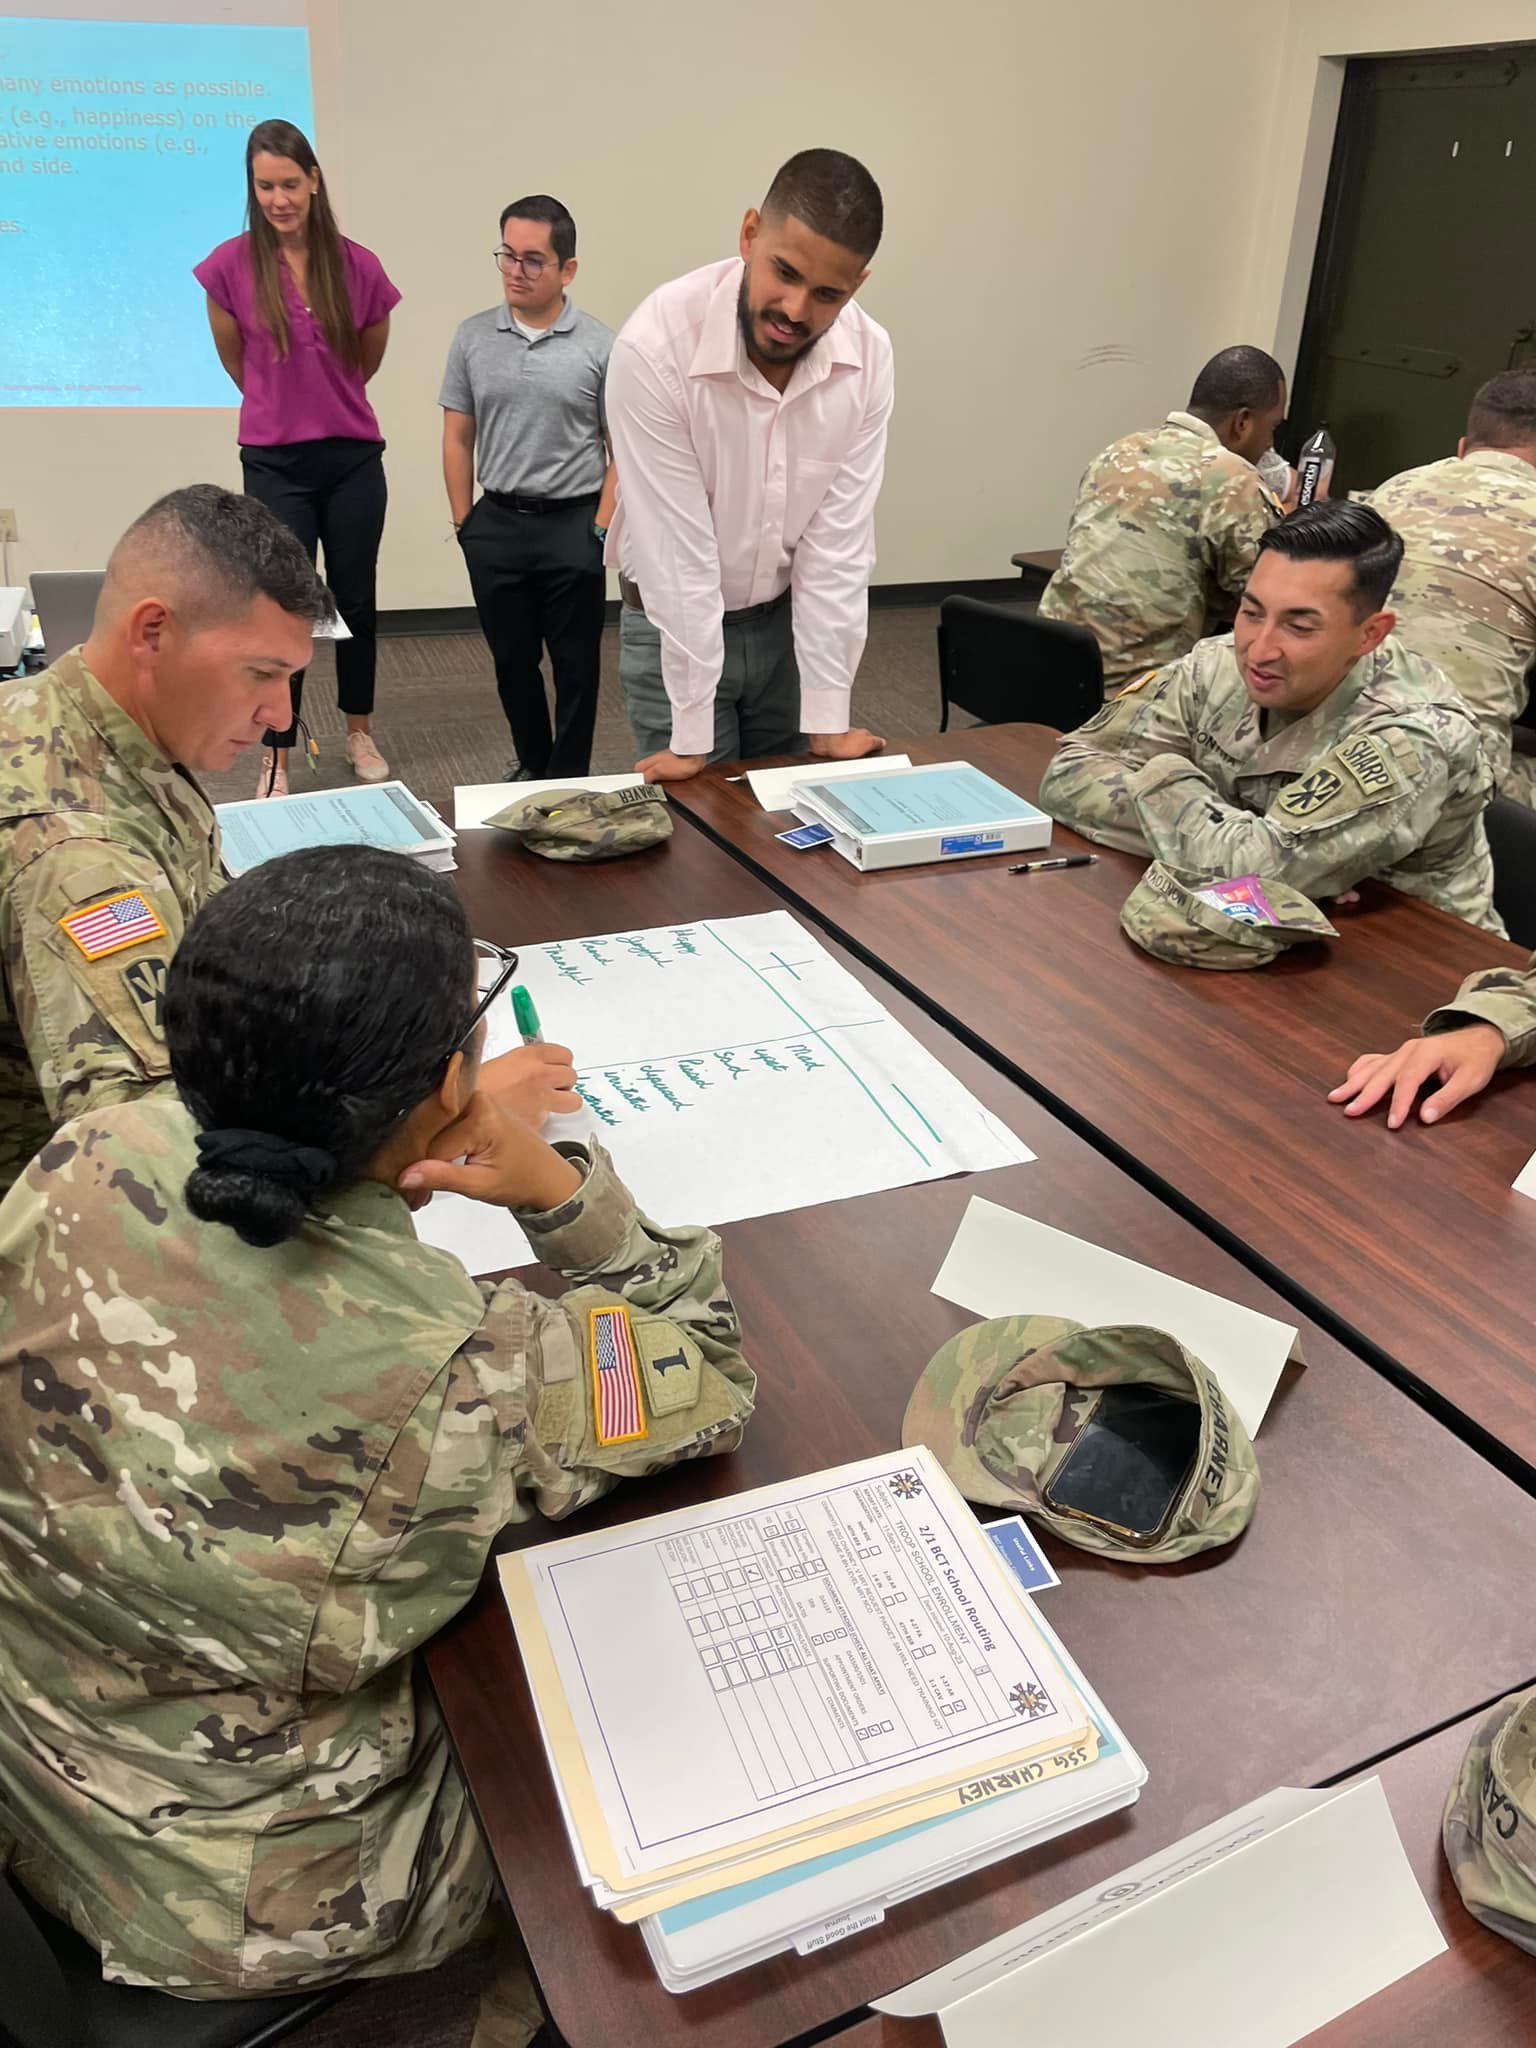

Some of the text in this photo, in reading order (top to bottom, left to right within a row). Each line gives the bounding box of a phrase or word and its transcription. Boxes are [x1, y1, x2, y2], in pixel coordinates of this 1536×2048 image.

[50, 76, 145, 95] emotions
[152, 80, 175, 95] as
[183, 79, 271, 98] possible.
[10, 106, 65, 128] (e.g.,
[72, 106, 185, 130] happiness)
[192, 111, 217, 127] on
[225, 110, 256, 128] the
[53, 132, 146, 151] emotions
[155, 134, 208, 155] (e.g.,
[32, 157, 79, 175] side.
[1342, 740, 1390, 787] SHARP
[580, 939, 614, 966] Proud
[616, 936, 673, 968] Joyful
[668, 929, 701, 956] Happy
[541, 943, 593, 986] Thankful
[714, 1051, 749, 1080] Sad
[786, 1044, 825, 1072] Mad
[604, 1068, 651, 1112] irritated
[1201, 1378, 1229, 1507] CHARNEY
[845, 1568, 860, 1586] LEVEL
[894, 1520, 916, 1549] TROOP
[910, 1549, 936, 1586] SCHOOL
[930, 1585, 970, 1646] ENROLLMENT
[916, 1524, 999, 1652] 2/1 BCT School Routing
[940, 1632, 964, 1665] 10-Aug-23
[821, 1656, 859, 1727] SUPPORTING DOCUMENTS
[833, 1653, 867, 1714] APPOINTMENT ORDERS
[915, 1686, 937, 1718] TRAINING
[958, 1746, 1087, 1805] SSG CHARNEY
[806, 1914, 878, 1950] Hunt the Good Stuff
[823, 1913, 852, 1931] Journal
